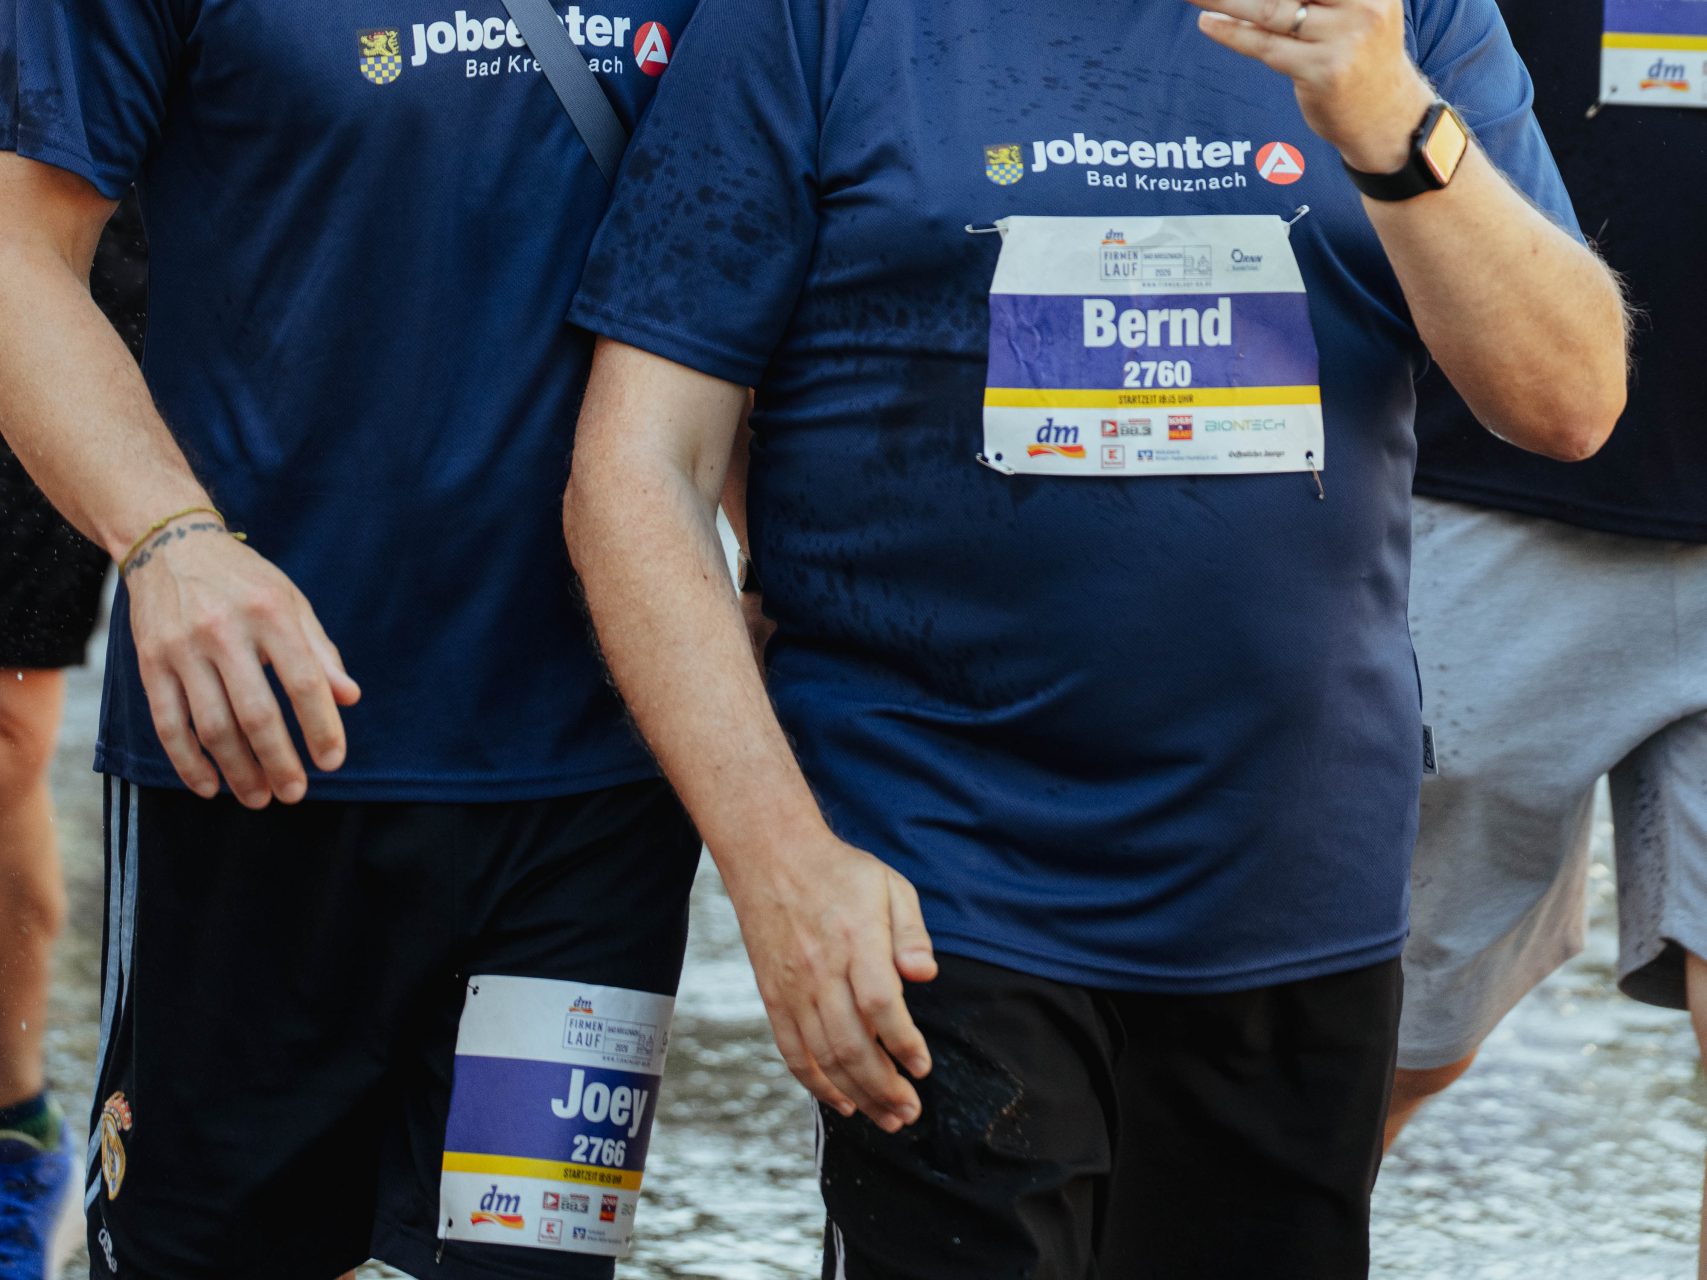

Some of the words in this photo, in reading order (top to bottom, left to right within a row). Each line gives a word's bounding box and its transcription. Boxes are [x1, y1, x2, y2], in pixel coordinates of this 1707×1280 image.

[411, 5, 630, 67] jobceter
[466, 56, 500, 78] Bad
[508, 54, 624, 74] Kreach
[1648, 58, 1685, 79] dm
[1031, 132, 1252, 172] jobcenter
[1086, 170, 1127, 188] Bad
[1135, 172, 1247, 192] Kreuznach
[1104, 250, 1139, 261] FIRMEN
[1104, 263, 1138, 277] LAUF
[1083, 297, 1232, 348] Bernd
[1123, 360, 1192, 388] 2760
[1118, 394, 1157, 405] STARTZEIT
[1036, 418, 1080, 445] dm
[1204, 419, 1286, 432] BIONTECH
[569, 1018, 604, 1033] FIRMEN
[567, 1031, 602, 1048] LAUF
[551, 1068, 648, 1138] Joey
[571, 1134, 626, 1167] 2766
[563, 1167, 598, 1182] STARTZEIT
[479, 1184, 521, 1213] dm
